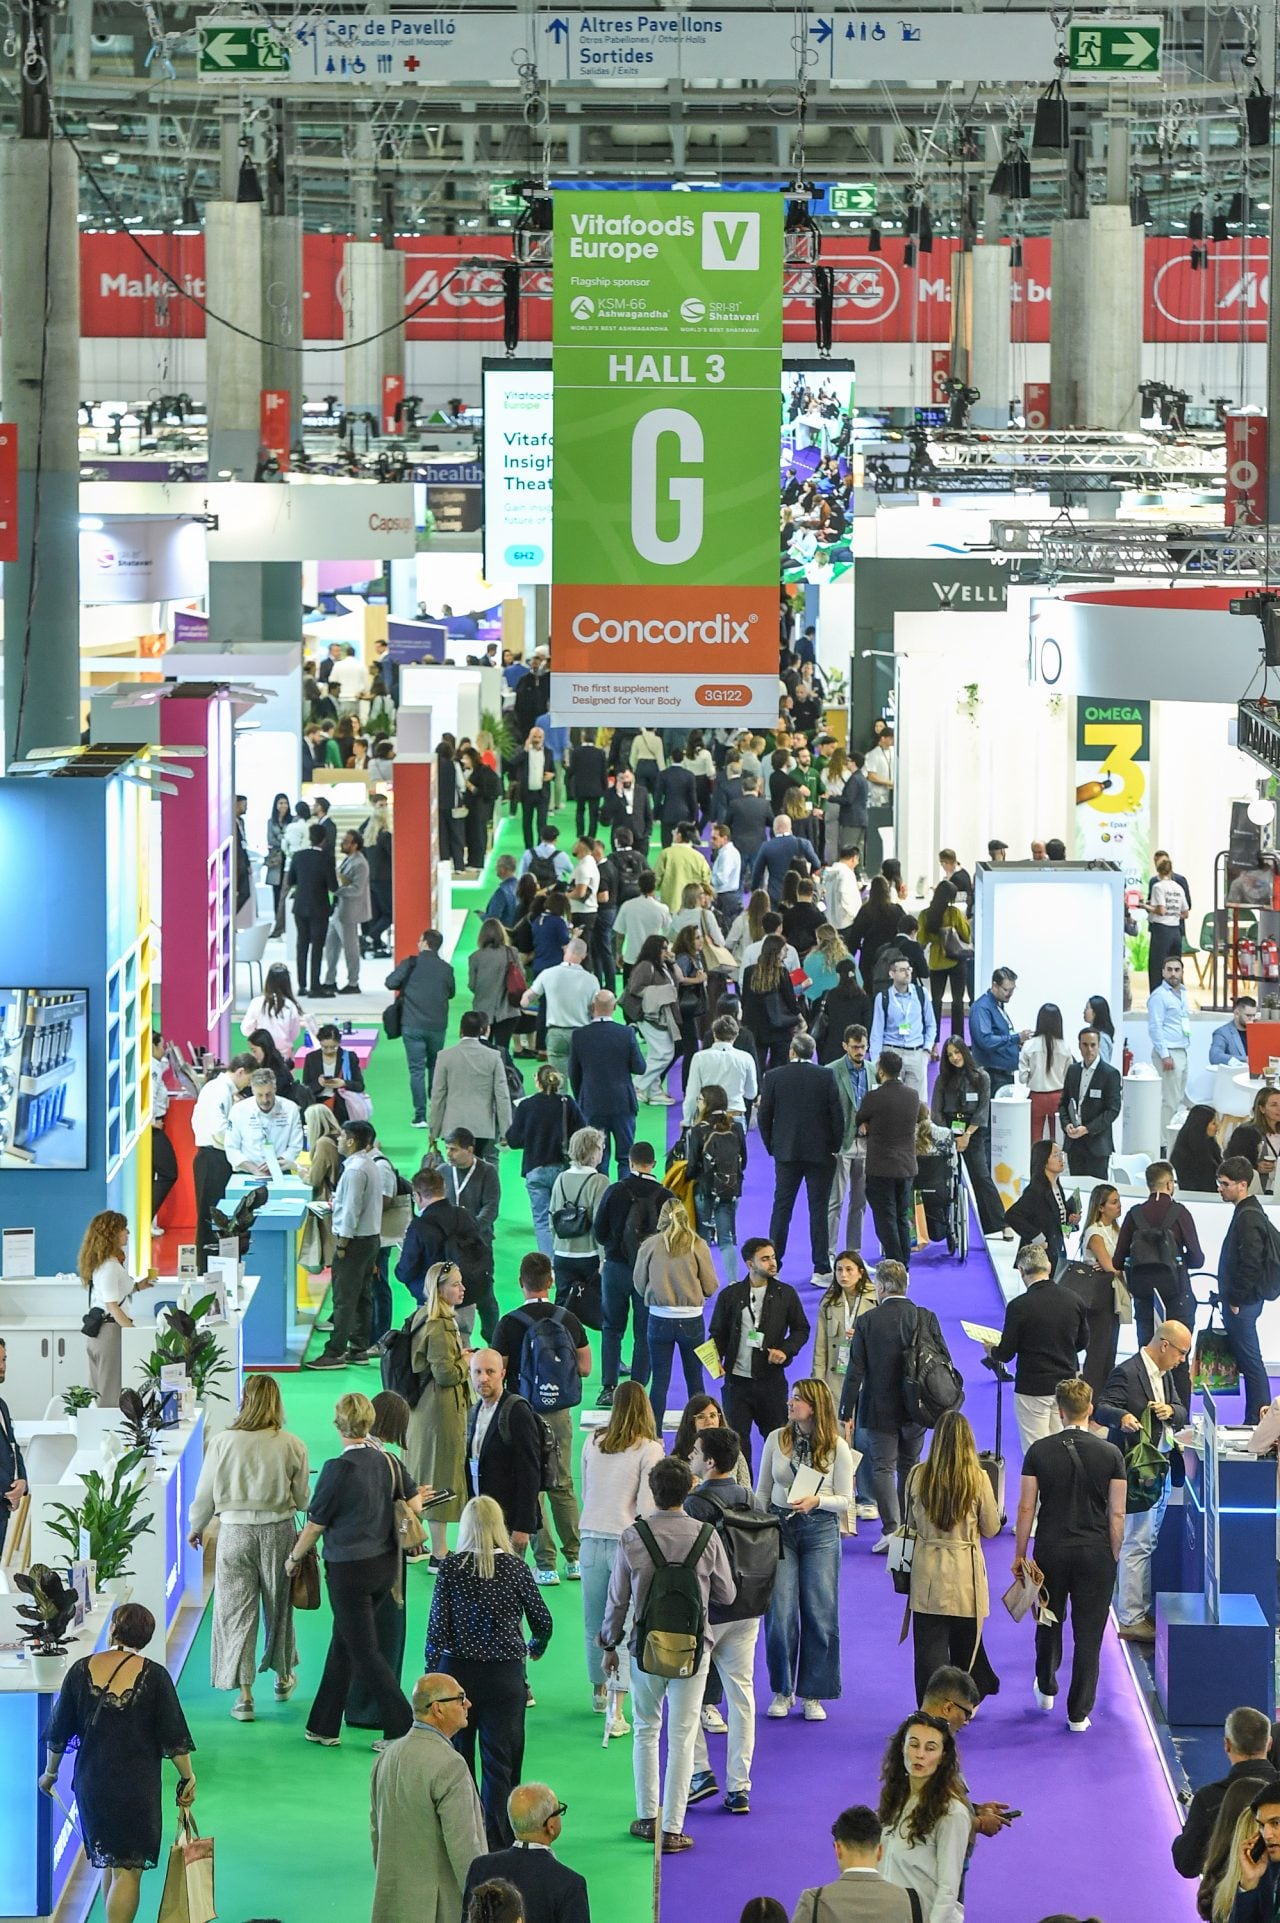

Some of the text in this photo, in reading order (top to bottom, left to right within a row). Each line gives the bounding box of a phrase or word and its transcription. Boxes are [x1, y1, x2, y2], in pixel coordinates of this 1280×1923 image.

[365, 20, 385, 35] de
[391, 19, 456, 35] Pavelló
[580, 16, 722, 32] Altres Pavellons
[580, 36, 602, 44] Otros
[605, 36, 649, 44] Pabellones
[580, 48, 653, 64] Sortides
[580, 67, 609, 75] Salidas
[618, 67, 638, 75] Exits
[570, 214, 695, 237] Vitafoods
[714, 221, 749, 262] V
[570, 237, 659, 263] Europe
[101, 273, 205, 297] Make it
[570, 277, 650, 288] Flagship sponsor
[598, 299, 646, 310] KSM-66
[598, 310, 668, 319] Ashwagandha
[709, 312, 759, 321] Shatavari
[609, 354, 725, 383] HALL 3
[427, 465, 482, 480] health
[631, 408, 704, 565] G
[514, 551, 535, 559] 6H2
[572, 684, 669, 695] The first supplement
[704, 690, 742, 701] 3G122
[572, 696, 681, 706] Designed for Your Body
[1085, 707, 1142, 720] OMEGA
[1085, 724, 1146, 814] 3
